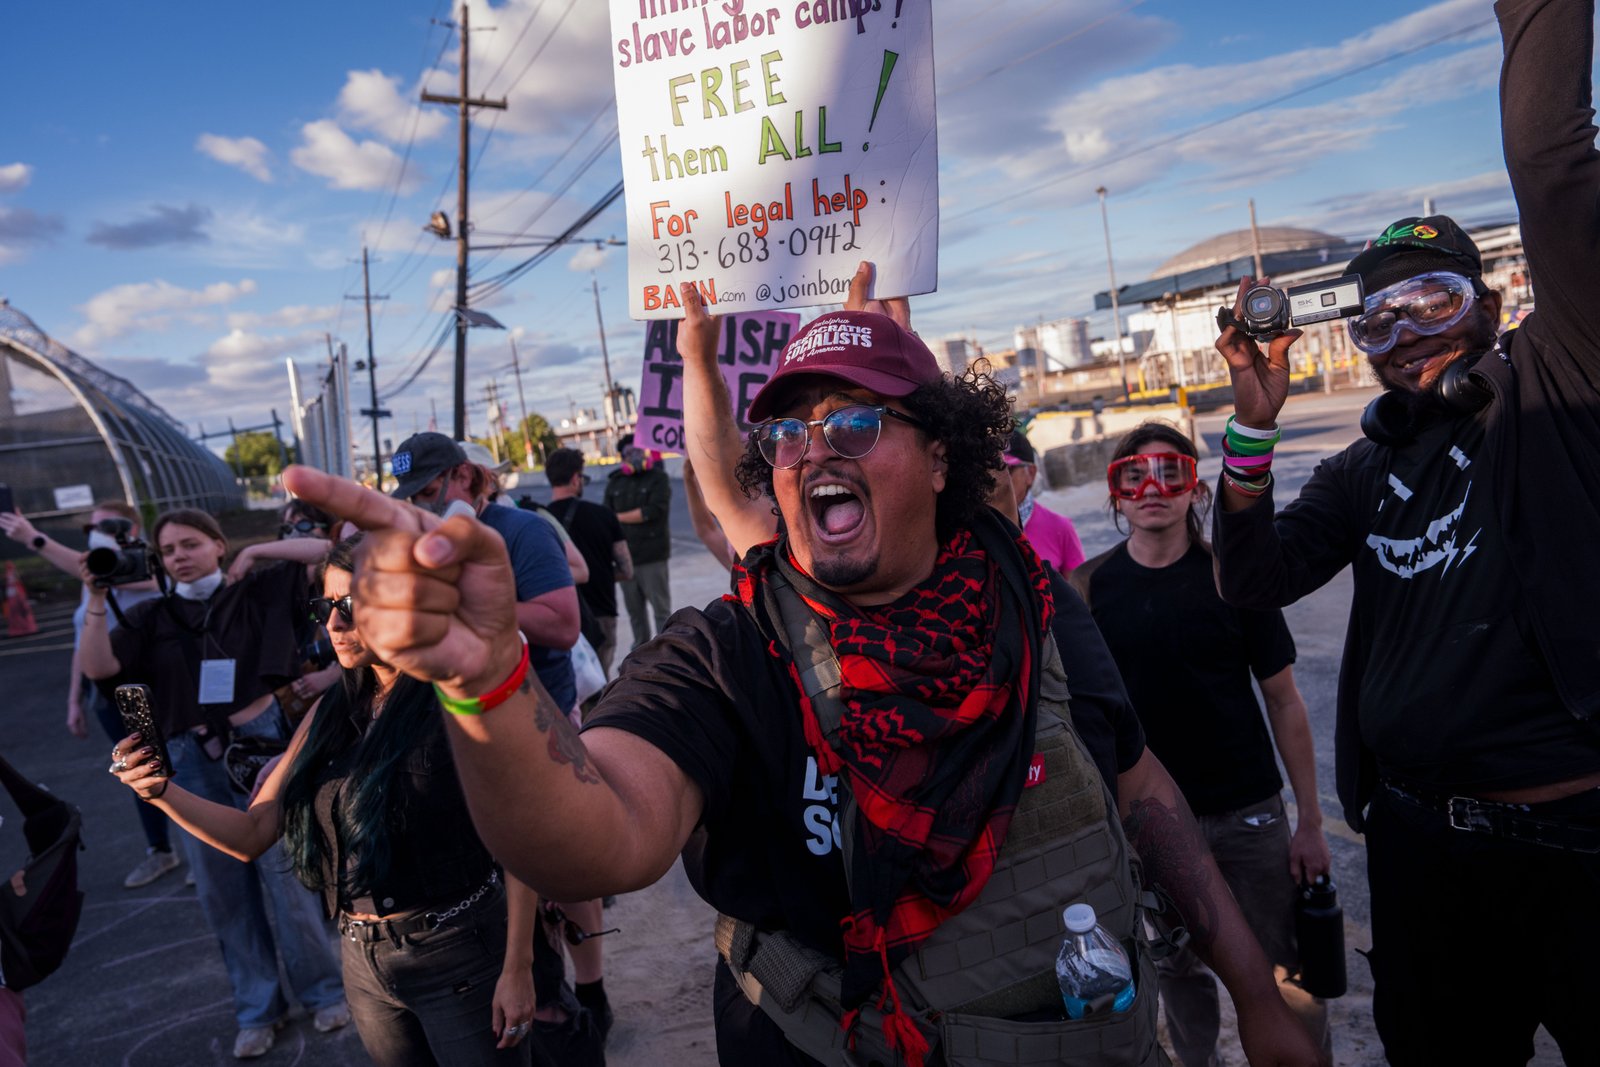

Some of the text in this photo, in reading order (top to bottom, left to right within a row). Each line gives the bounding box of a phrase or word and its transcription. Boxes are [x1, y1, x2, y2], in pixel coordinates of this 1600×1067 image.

[618, 22, 696, 68] slave
[701, 7, 780, 50] labor
[668, 50, 787, 127] FREE
[642, 134, 728, 182] them
[758, 106, 842, 165] ALL
[650, 200, 699, 240] For
[725, 182, 793, 238] legal
[658, 221, 861, 274] 313-683-0942
[643, 278, 746, 311] BAN.com
[644, 315, 791, 366] AISH
[784, 331, 873, 366] SOCIALISTS
[643, 363, 769, 432] IE
